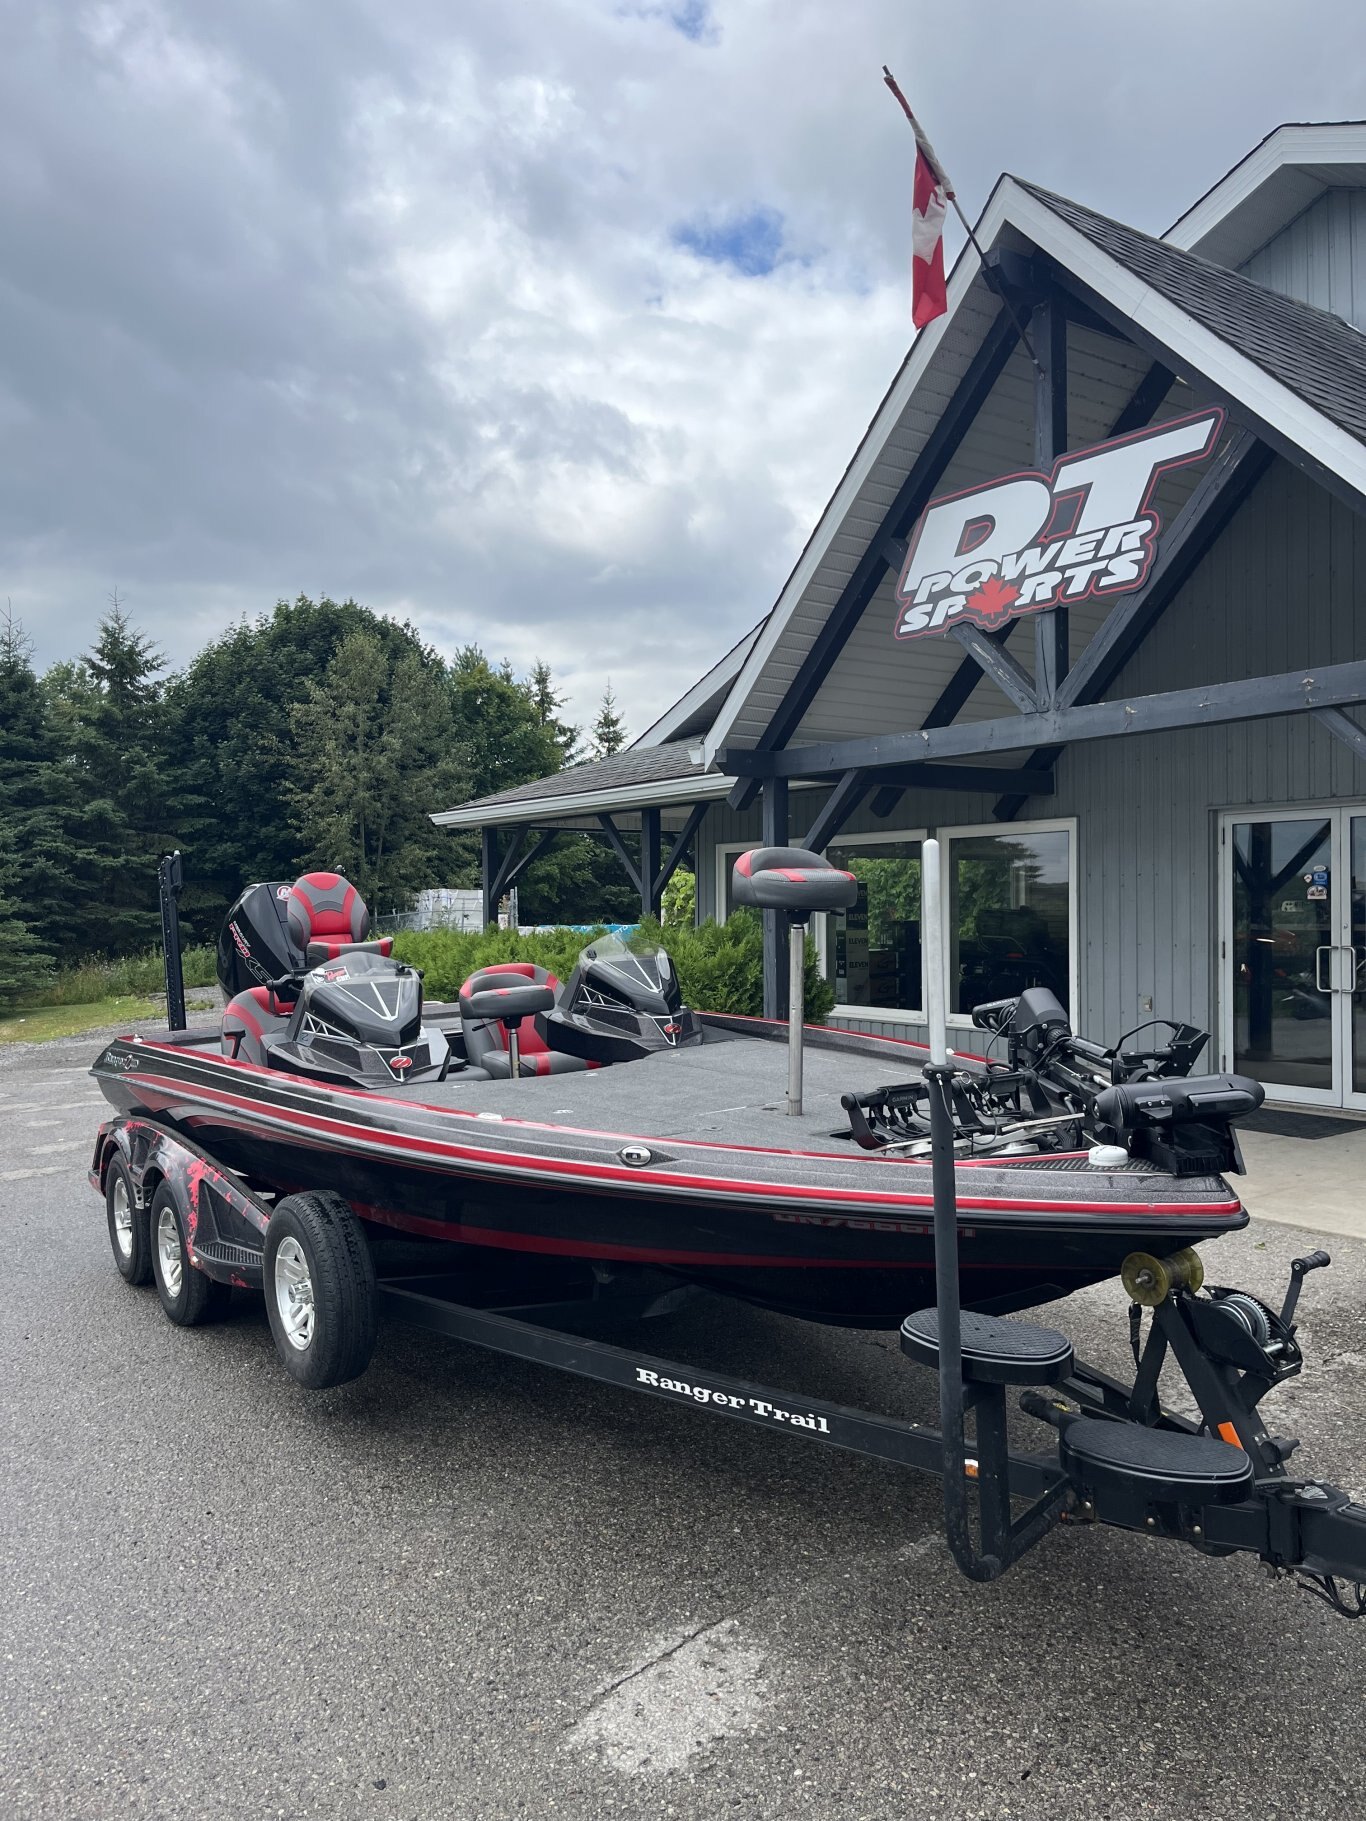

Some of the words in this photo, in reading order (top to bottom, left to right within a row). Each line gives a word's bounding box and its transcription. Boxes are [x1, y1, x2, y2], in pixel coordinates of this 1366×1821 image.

[903, 417, 1215, 593] DT
[900, 551, 1145, 633] SPRTS
[913, 519, 1152, 604] POWER
[636, 1367, 746, 1410] Ranger
[750, 1398, 831, 1434] Trail
